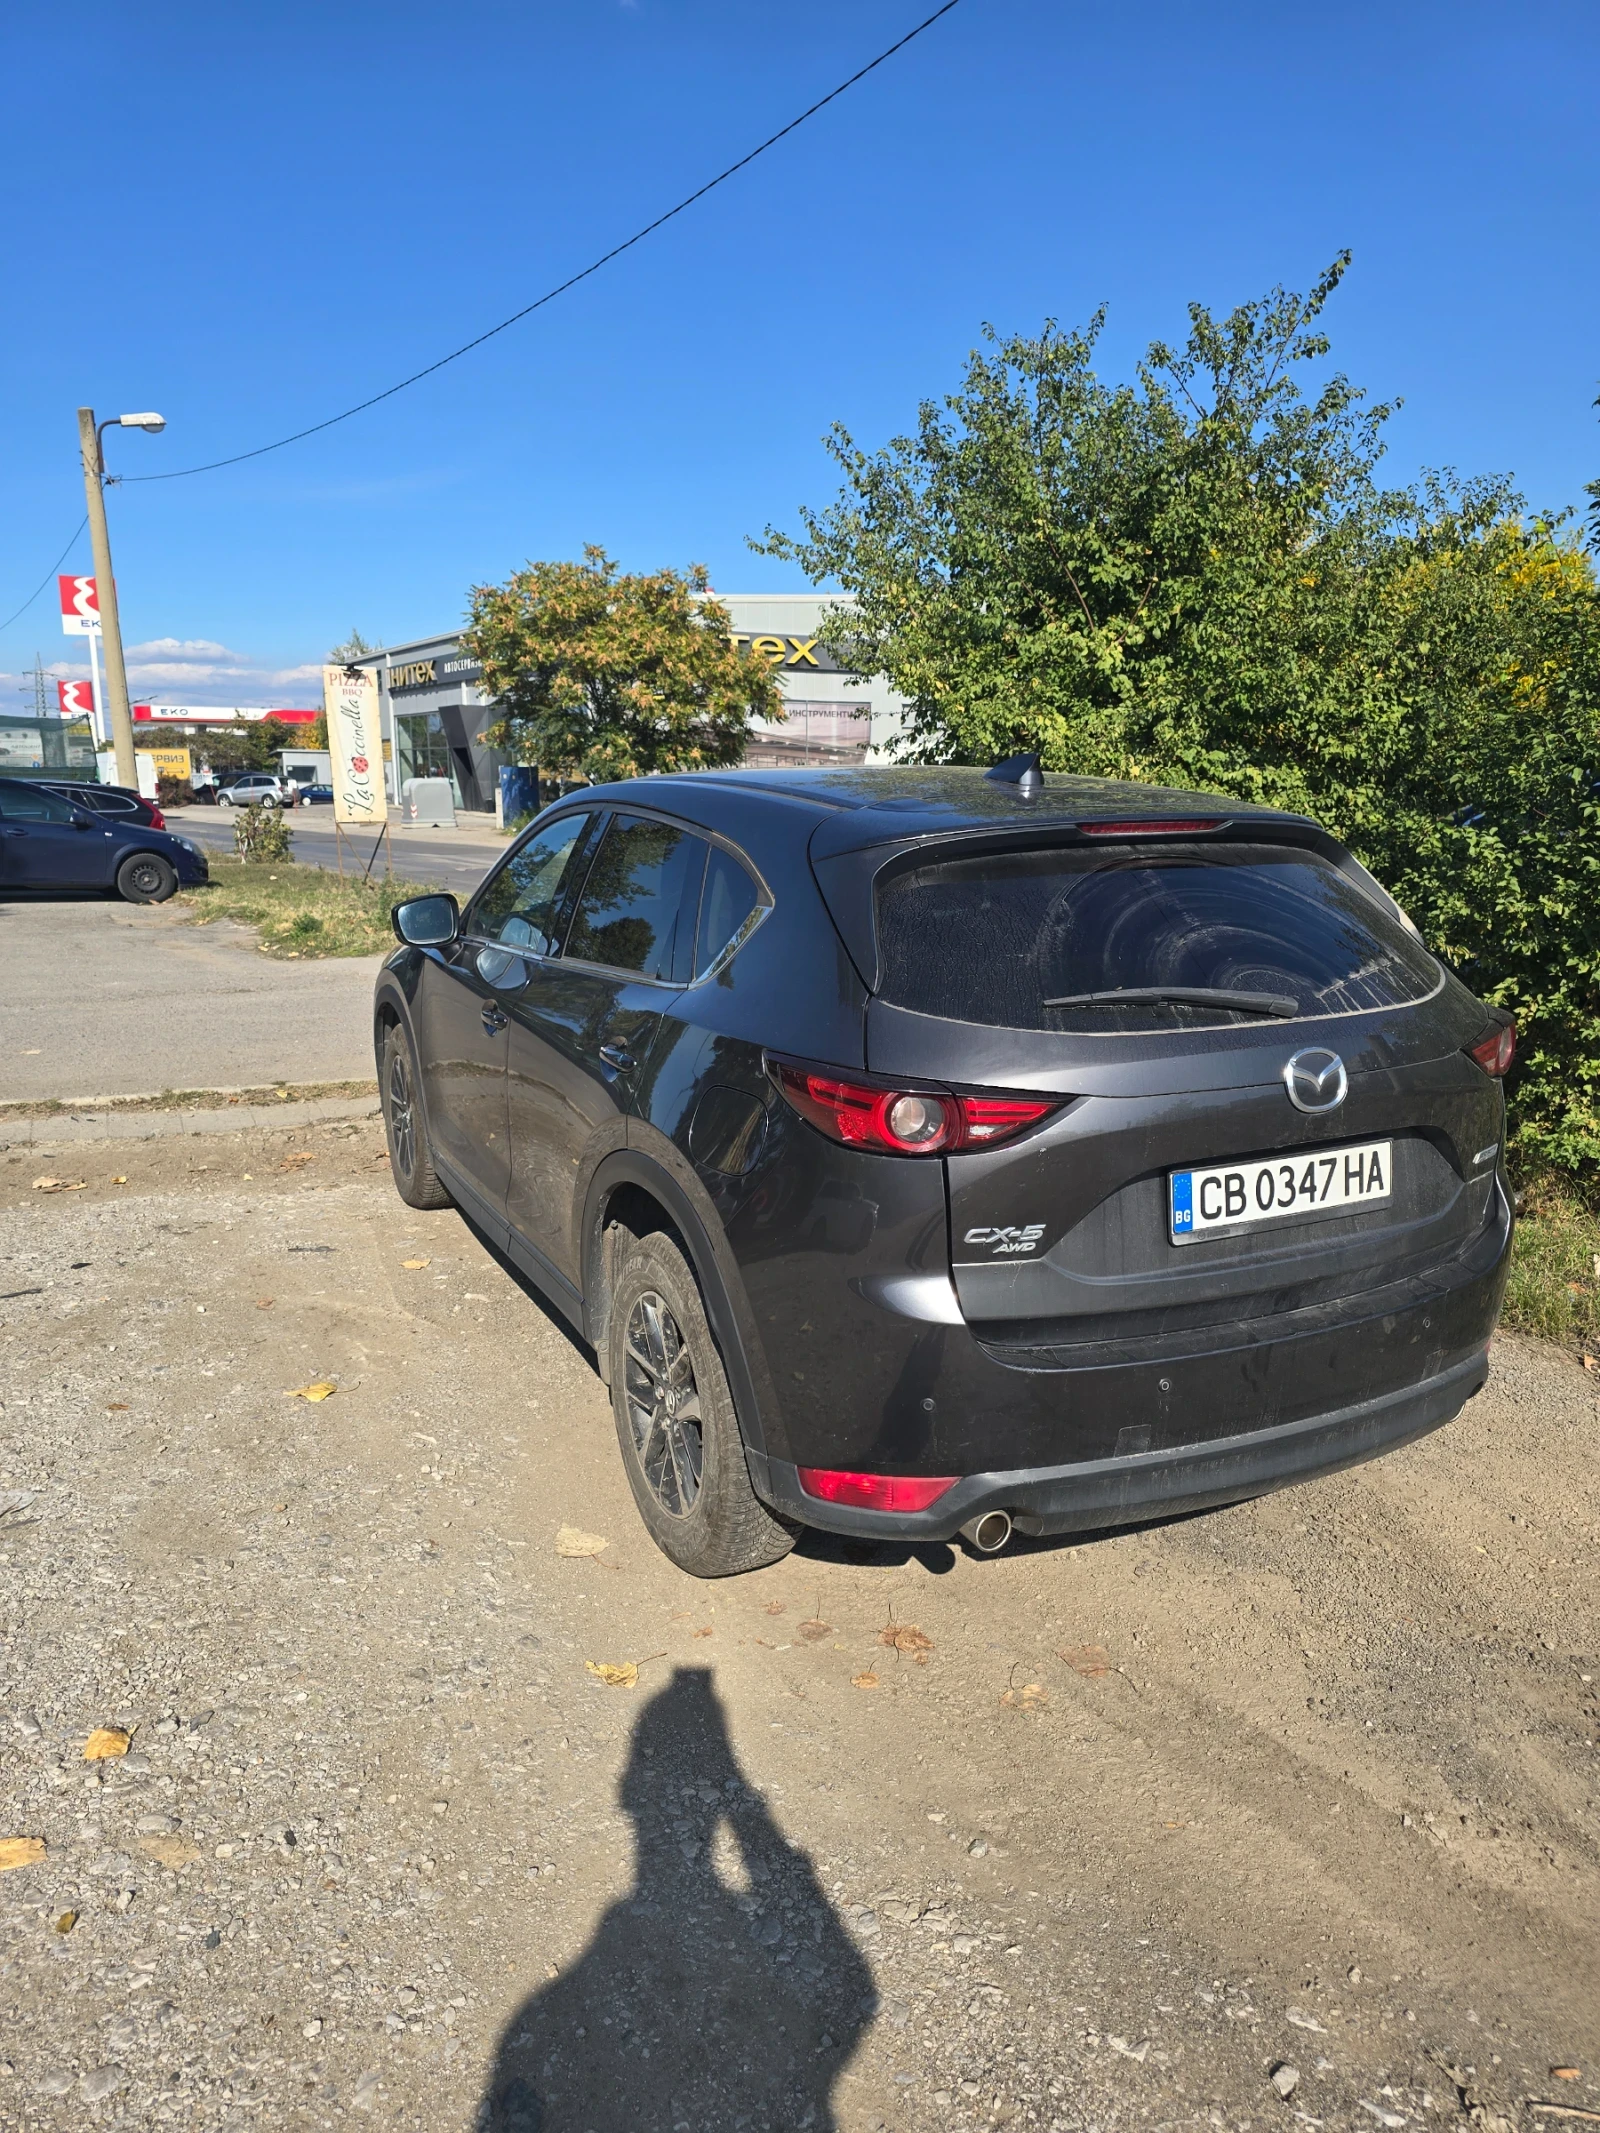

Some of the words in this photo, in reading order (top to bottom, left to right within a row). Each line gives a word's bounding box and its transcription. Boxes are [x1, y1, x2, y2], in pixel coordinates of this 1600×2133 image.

[81, 619, 102, 628] EK
[328, 672, 373, 687] PIZZA
[342, 688, 363, 698] BBQ
[160, 708, 189, 716] EKO
[1200, 1173, 1246, 1220] CB
[1255, 1158, 1337, 1211] 0347
[1344, 1151, 1384, 1196] HA
[1175, 1211, 1191, 1224] BG
[964, 1224, 1046, 1243] CX-5
[993, 1242, 1036, 1253] AWD
